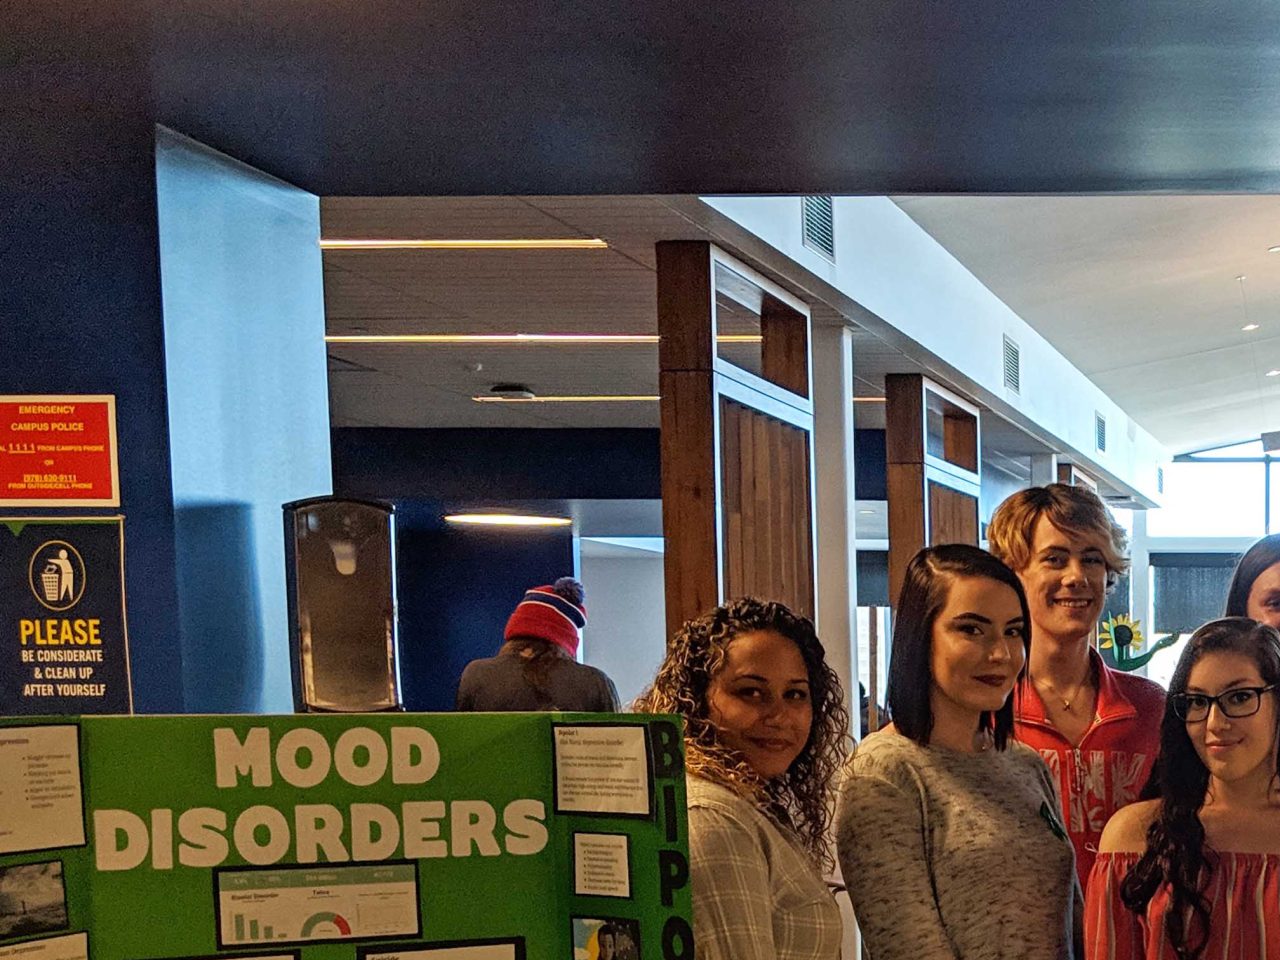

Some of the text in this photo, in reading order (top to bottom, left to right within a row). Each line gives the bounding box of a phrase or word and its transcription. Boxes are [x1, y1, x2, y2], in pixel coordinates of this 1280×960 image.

[19, 405, 75, 414] EMERGENCY
[11, 422, 84, 431] CAMPUS POLICE
[20, 618, 102, 645] PLEASE
[22, 650, 103, 662] BE CONSIDERATE
[34, 667, 94, 679] & CLEAN UP
[24, 684, 106, 697] AFTER YOURSELF
[213, 726, 441, 789] MOOD
[93, 798, 549, 872] DISORDERS
